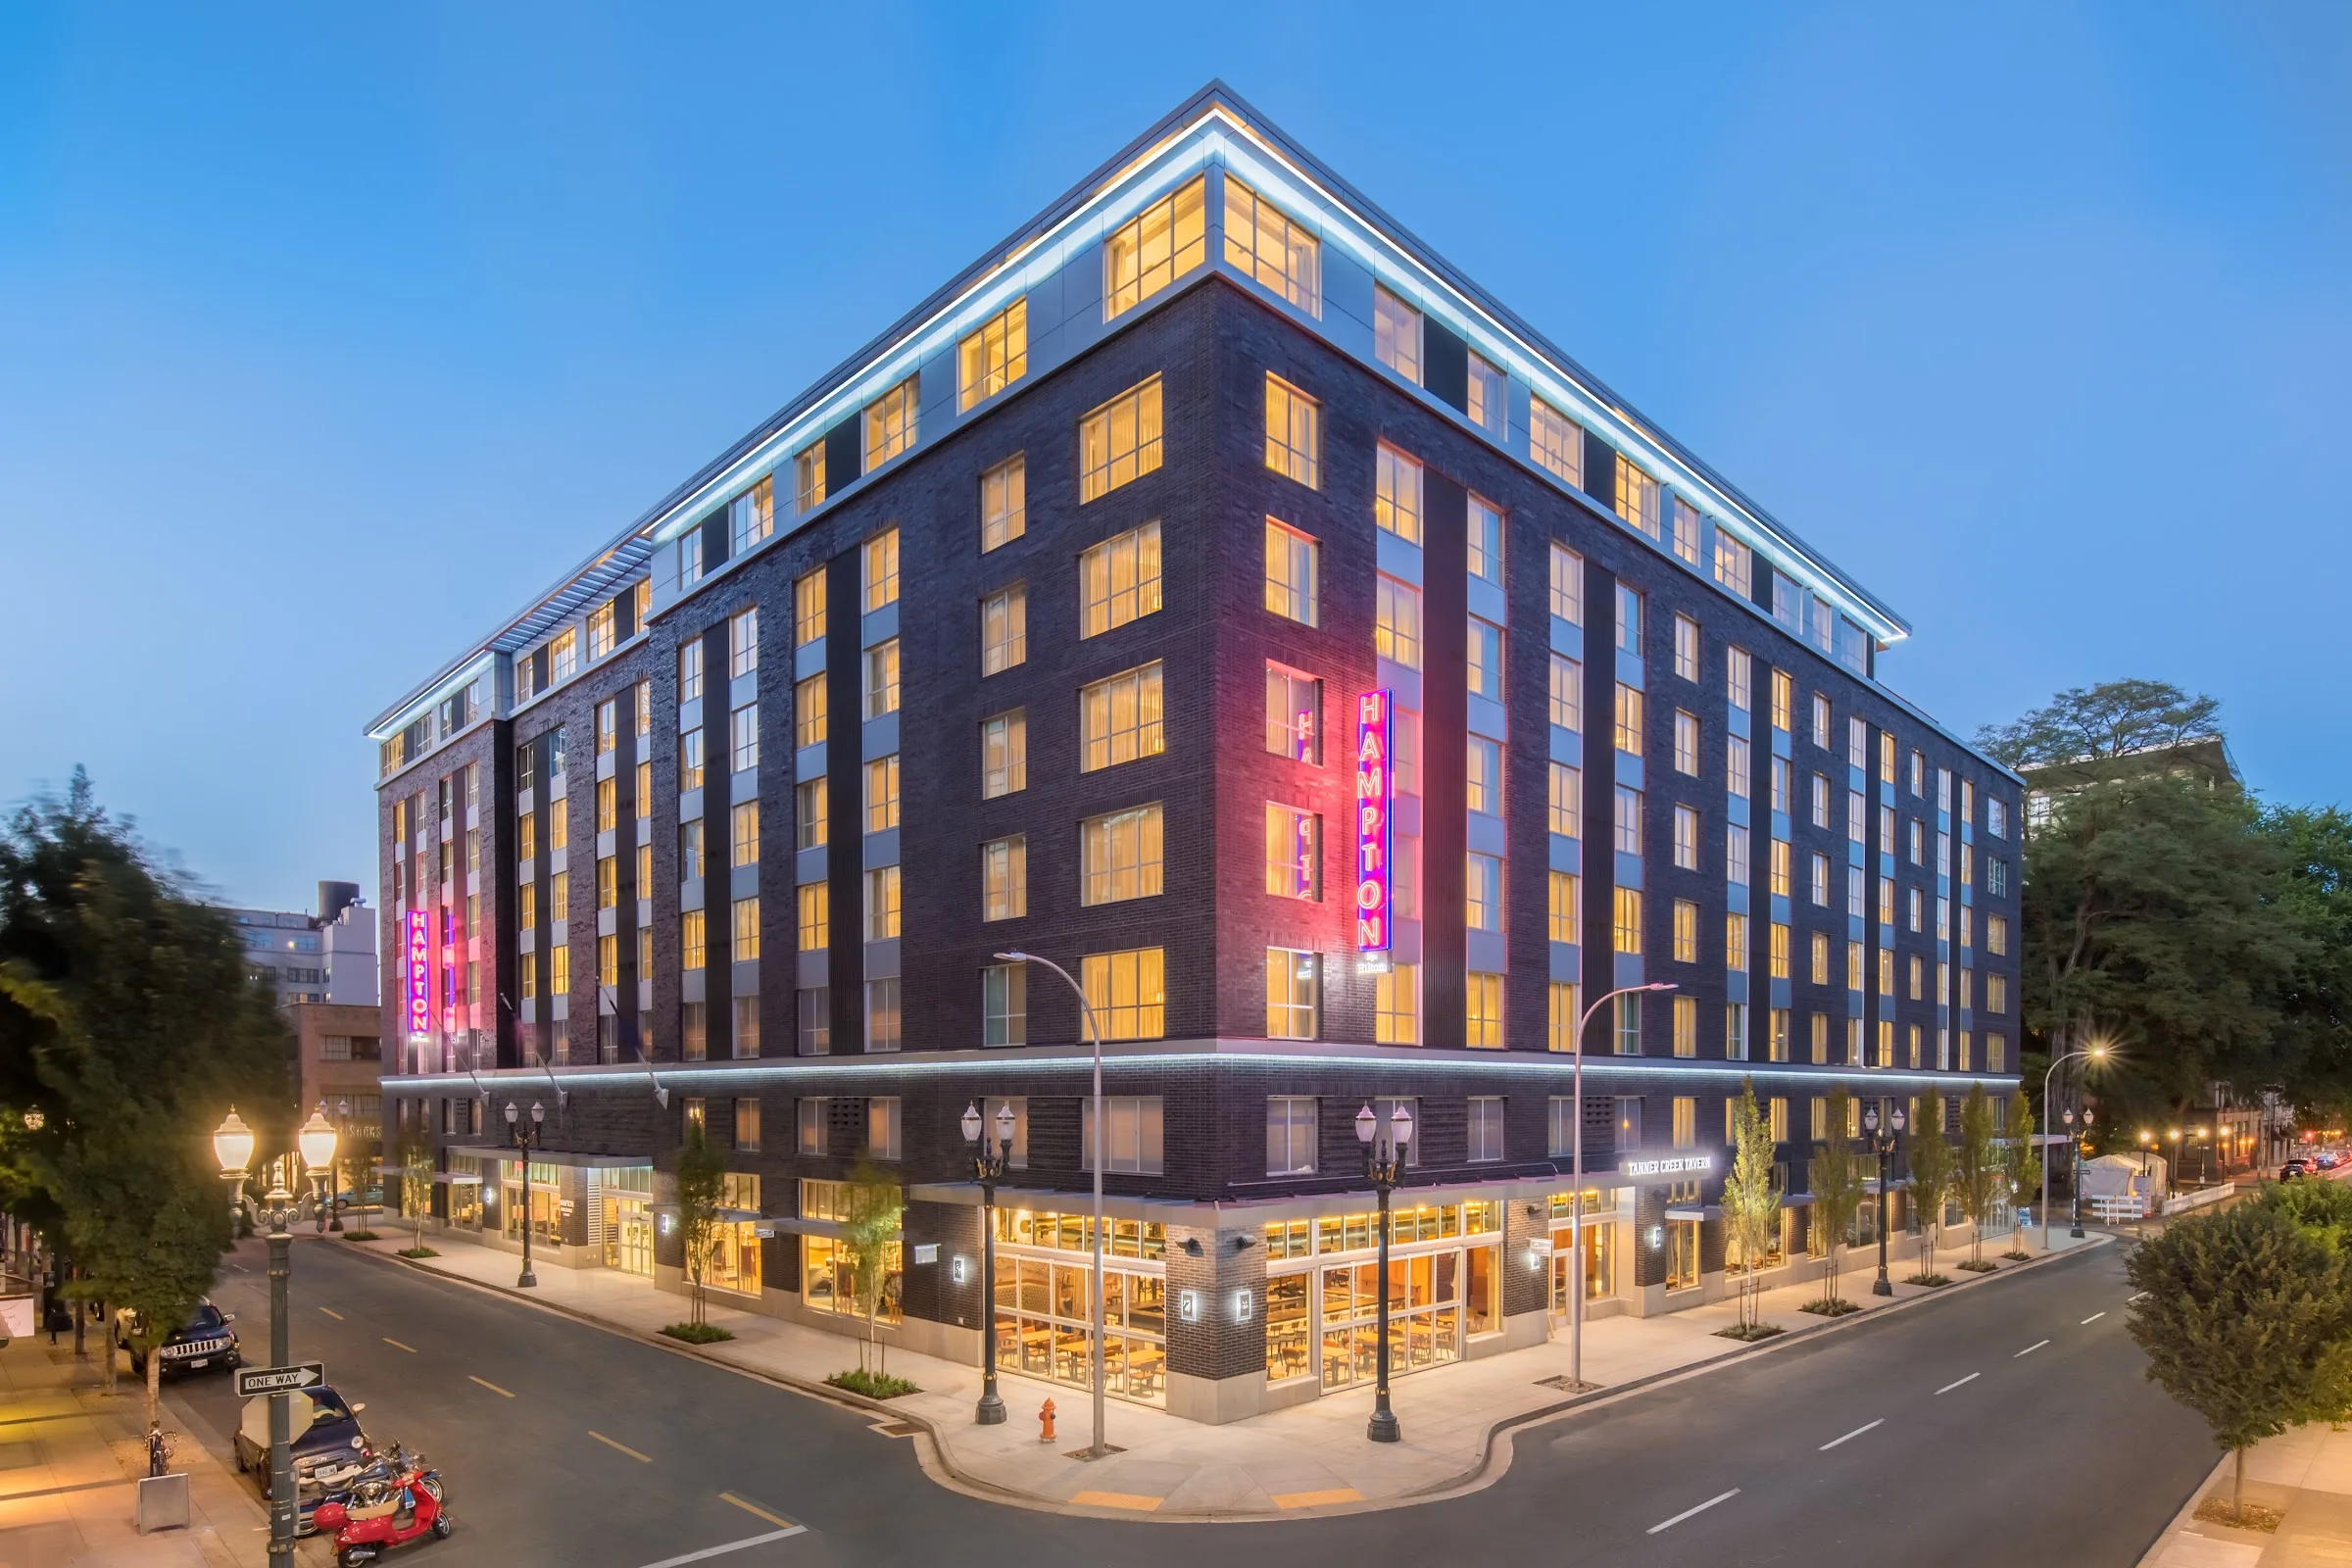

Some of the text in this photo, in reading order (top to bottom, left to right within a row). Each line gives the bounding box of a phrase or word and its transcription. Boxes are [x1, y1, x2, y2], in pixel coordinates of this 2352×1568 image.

[1357, 693, 1384, 947] HAMPTON
[412, 912, 427, 1030] HAMPTON
[1628, 1156, 1711, 1176] TANNER CREEK TAVERN
[248, 1373, 299, 1388] ONE WAY
